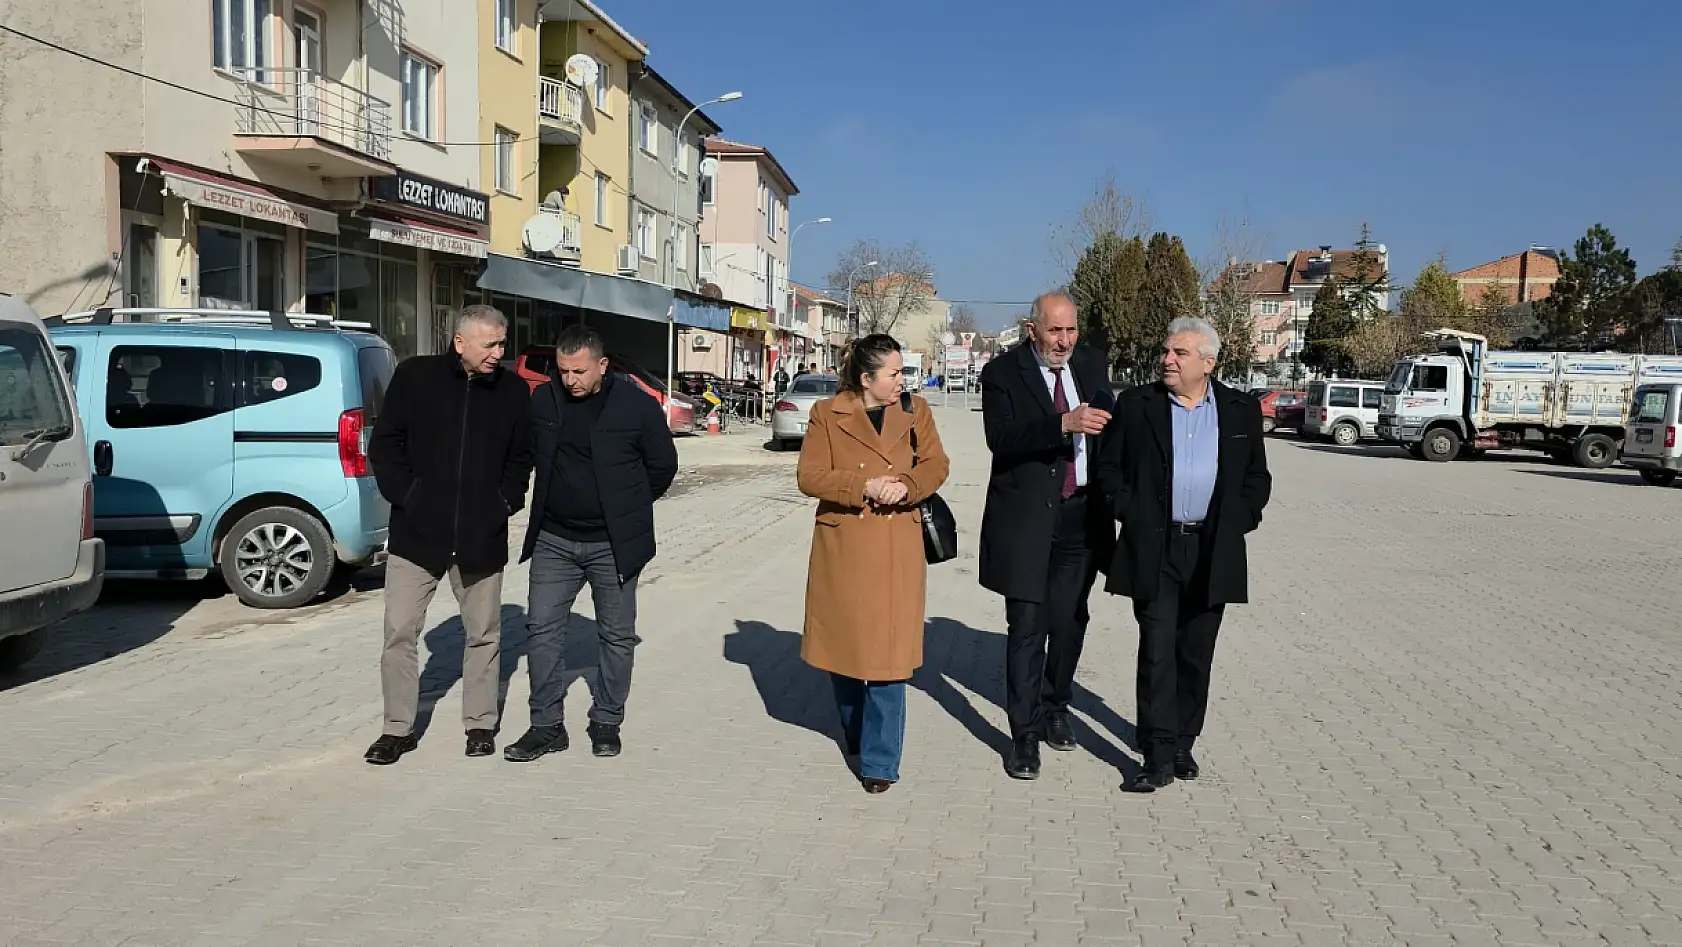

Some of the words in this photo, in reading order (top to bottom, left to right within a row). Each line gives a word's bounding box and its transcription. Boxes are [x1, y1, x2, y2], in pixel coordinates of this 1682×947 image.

[203, 189, 245, 209] LEZZET
[249, 200, 309, 224] LOKANTASI
[398, 177, 433, 207] LEZZET
[434, 188, 486, 221] LOKANTASI
